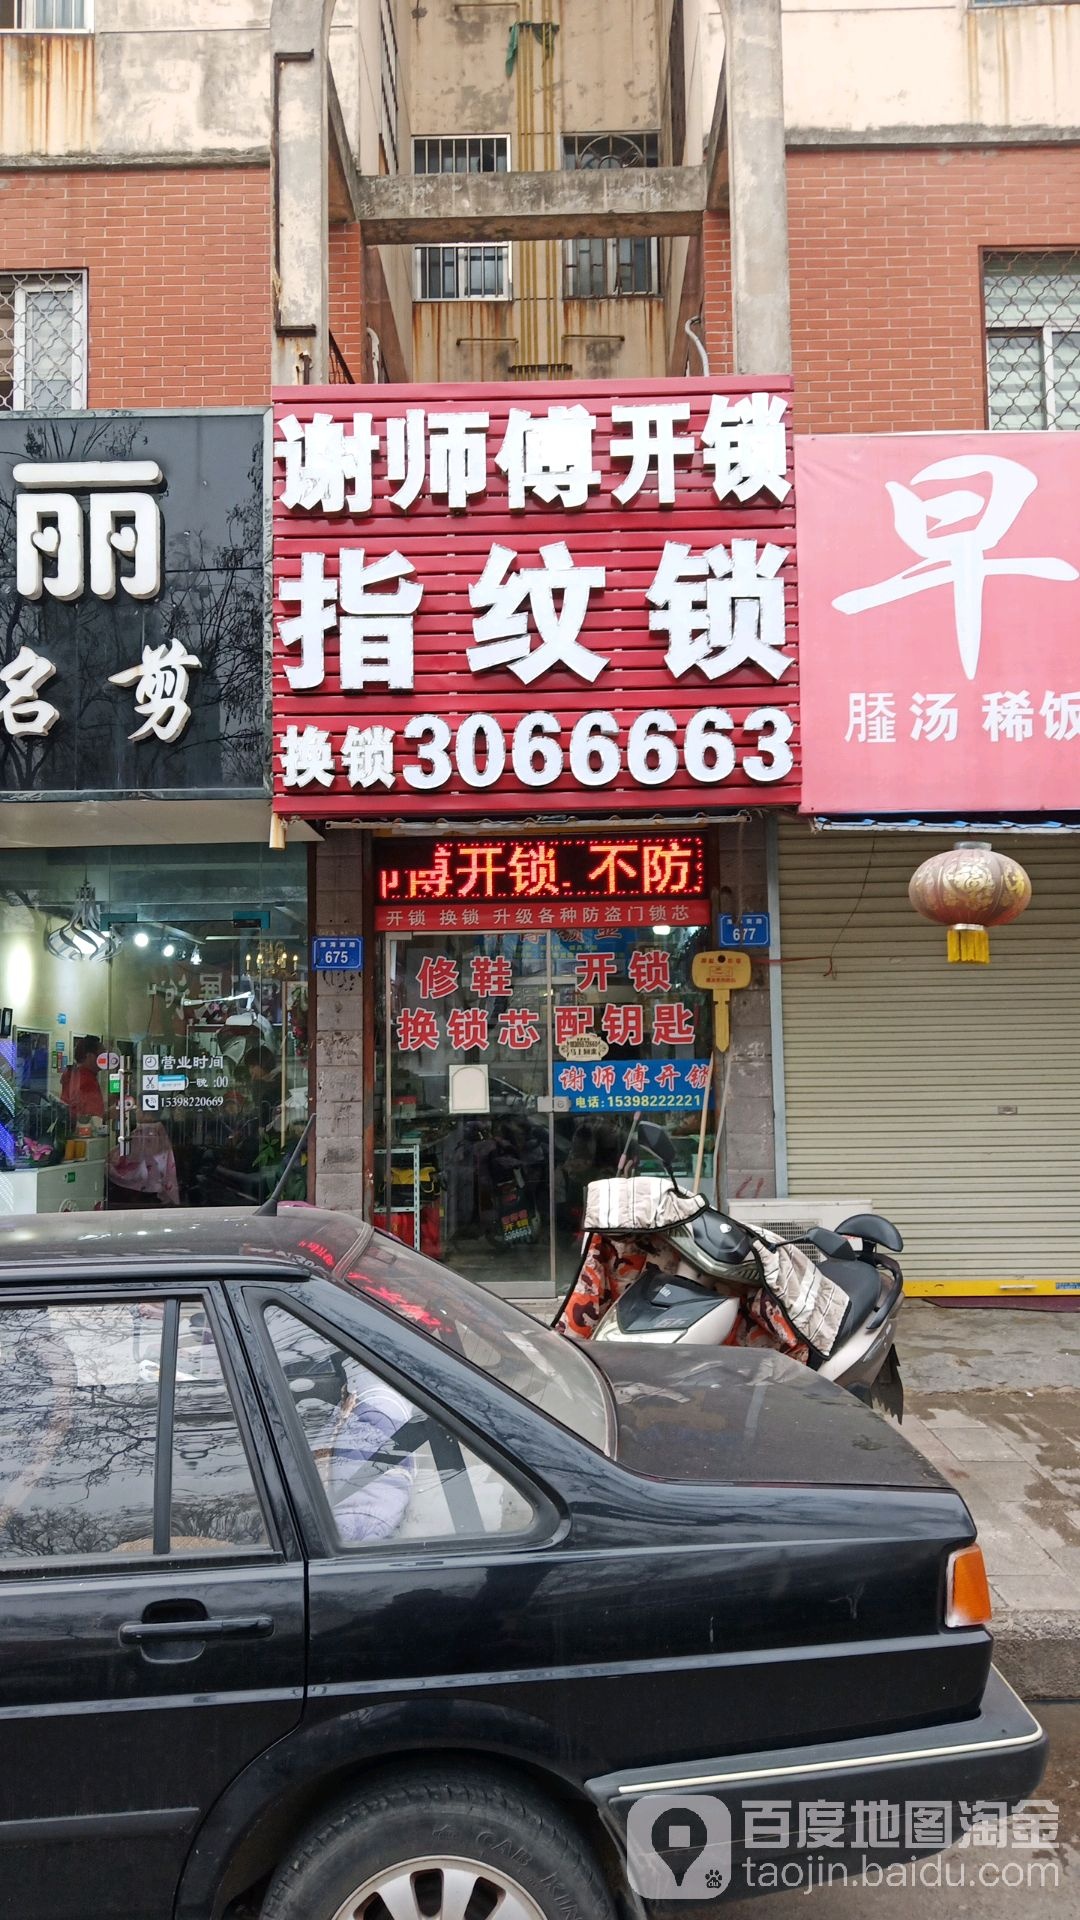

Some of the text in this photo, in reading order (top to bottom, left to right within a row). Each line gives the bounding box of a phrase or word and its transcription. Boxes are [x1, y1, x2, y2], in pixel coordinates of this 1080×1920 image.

[273, 393, 793, 513] 谢师傅开锁
[12, 461, 164, 600] 丽
[832, 454, 1080, 681] 早
[278, 538, 795, 693] 指纹锁
[0, 638, 202, 744] 名剪
[981, 689, 1080, 743] 稀饭
[386, 904, 690, 927] 开锁 换锁 升级各种防盗门锁芯
[733, 927, 756, 941] 677
[325, 950, 348, 964] 675
[416, 950, 672, 999] 修鞋 开锁
[161, 1055, 224, 1070] 营业时间
[558, 1063, 710, 1094] 谢师傅开锁
[161, 1096, 224, 1107] 15398220669
